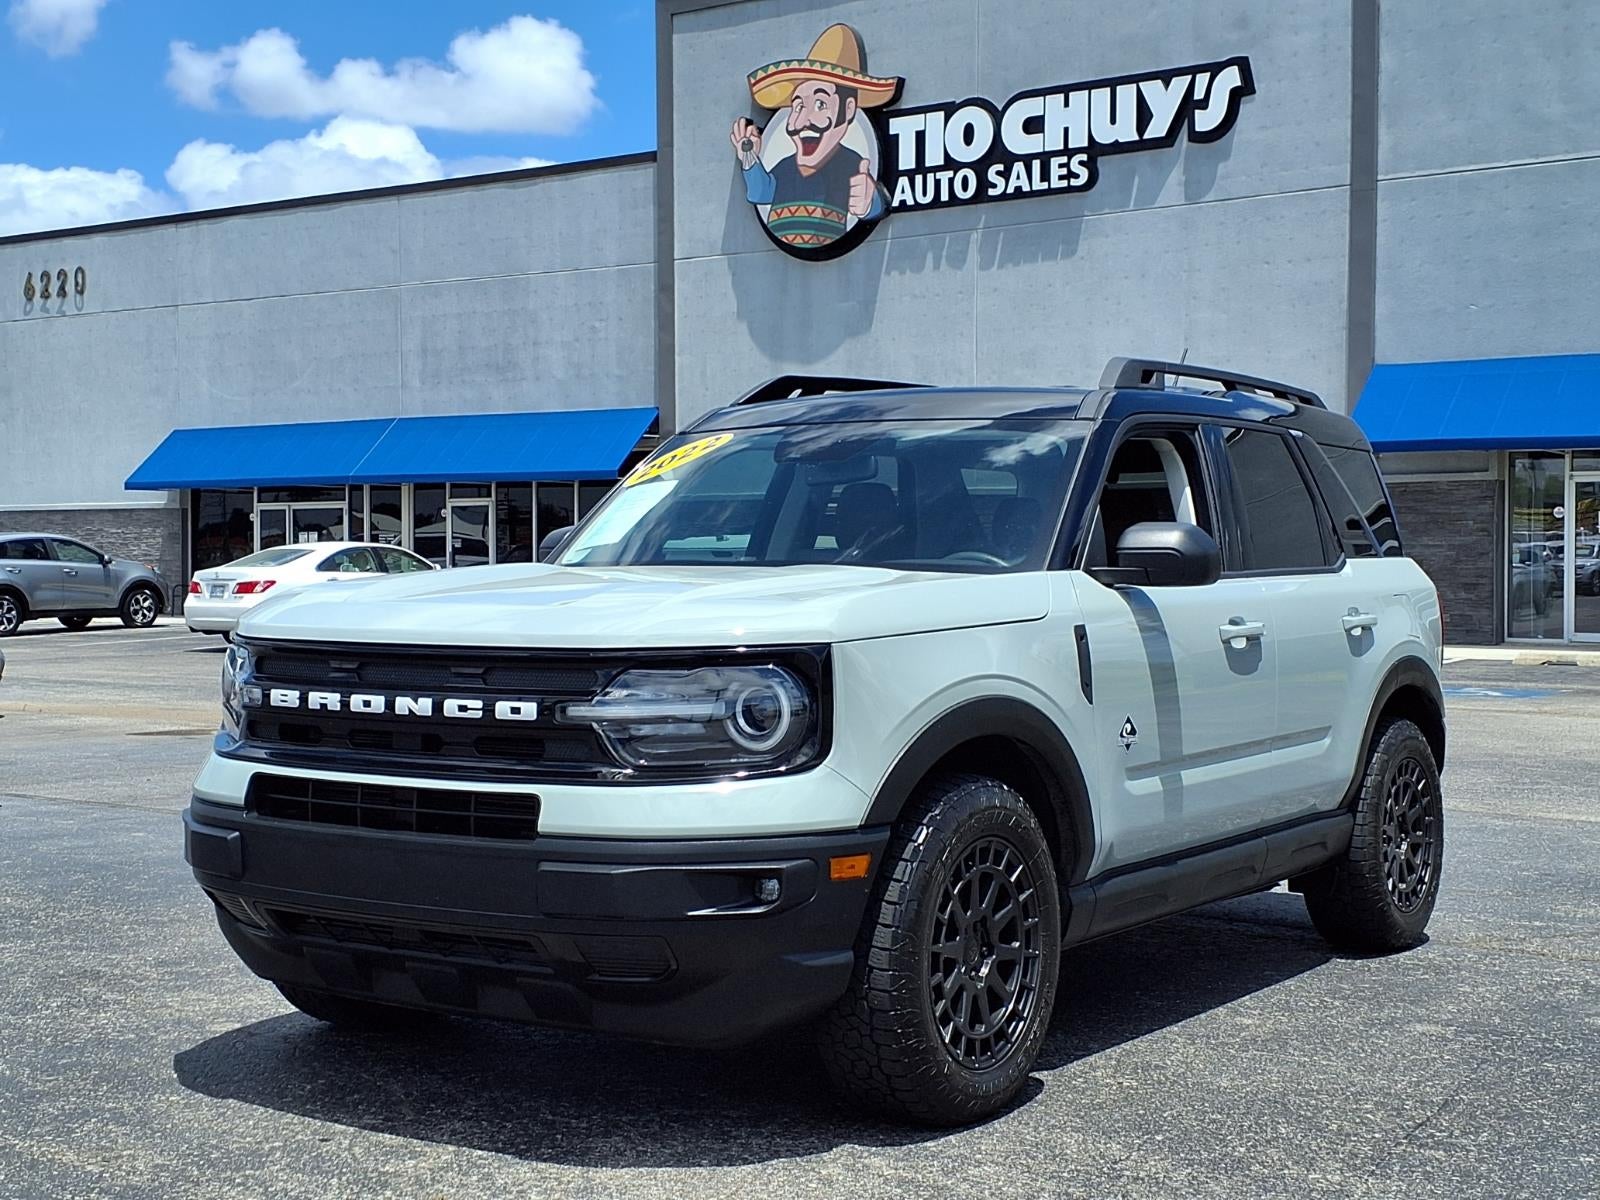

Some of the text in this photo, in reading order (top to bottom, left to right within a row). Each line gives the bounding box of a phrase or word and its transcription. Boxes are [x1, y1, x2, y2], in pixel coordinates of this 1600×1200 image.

[889, 65, 1242, 171] TIO CHUY'S
[891, 153, 1089, 207] AUTO SALES
[23, 266, 86, 301] 6220
[635, 436, 723, 481] 2022
[269, 688, 538, 721] BRONCO
